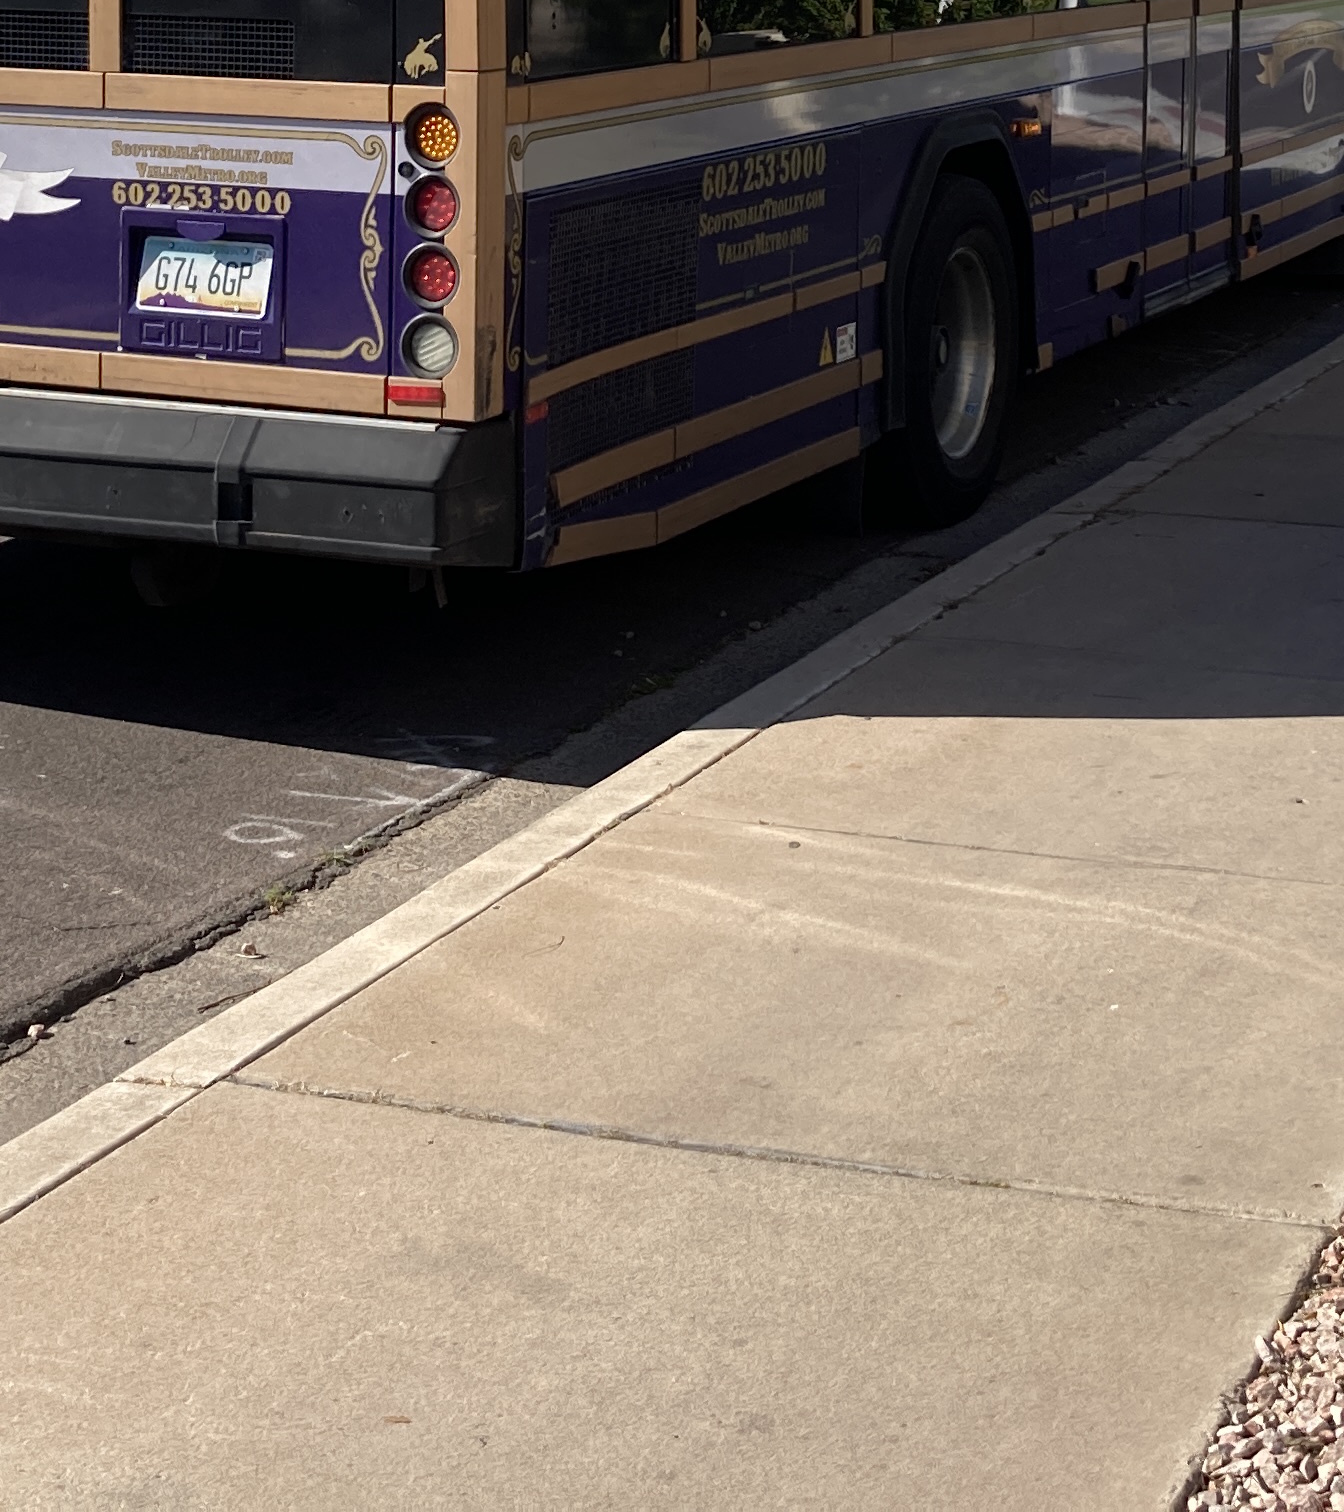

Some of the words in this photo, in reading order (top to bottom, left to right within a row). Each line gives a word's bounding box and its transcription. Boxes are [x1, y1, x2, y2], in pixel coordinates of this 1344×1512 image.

[154, 255, 198, 294] G74
[207, 259, 254, 298] 6GP
[141, 320, 262, 355] GILLIG
